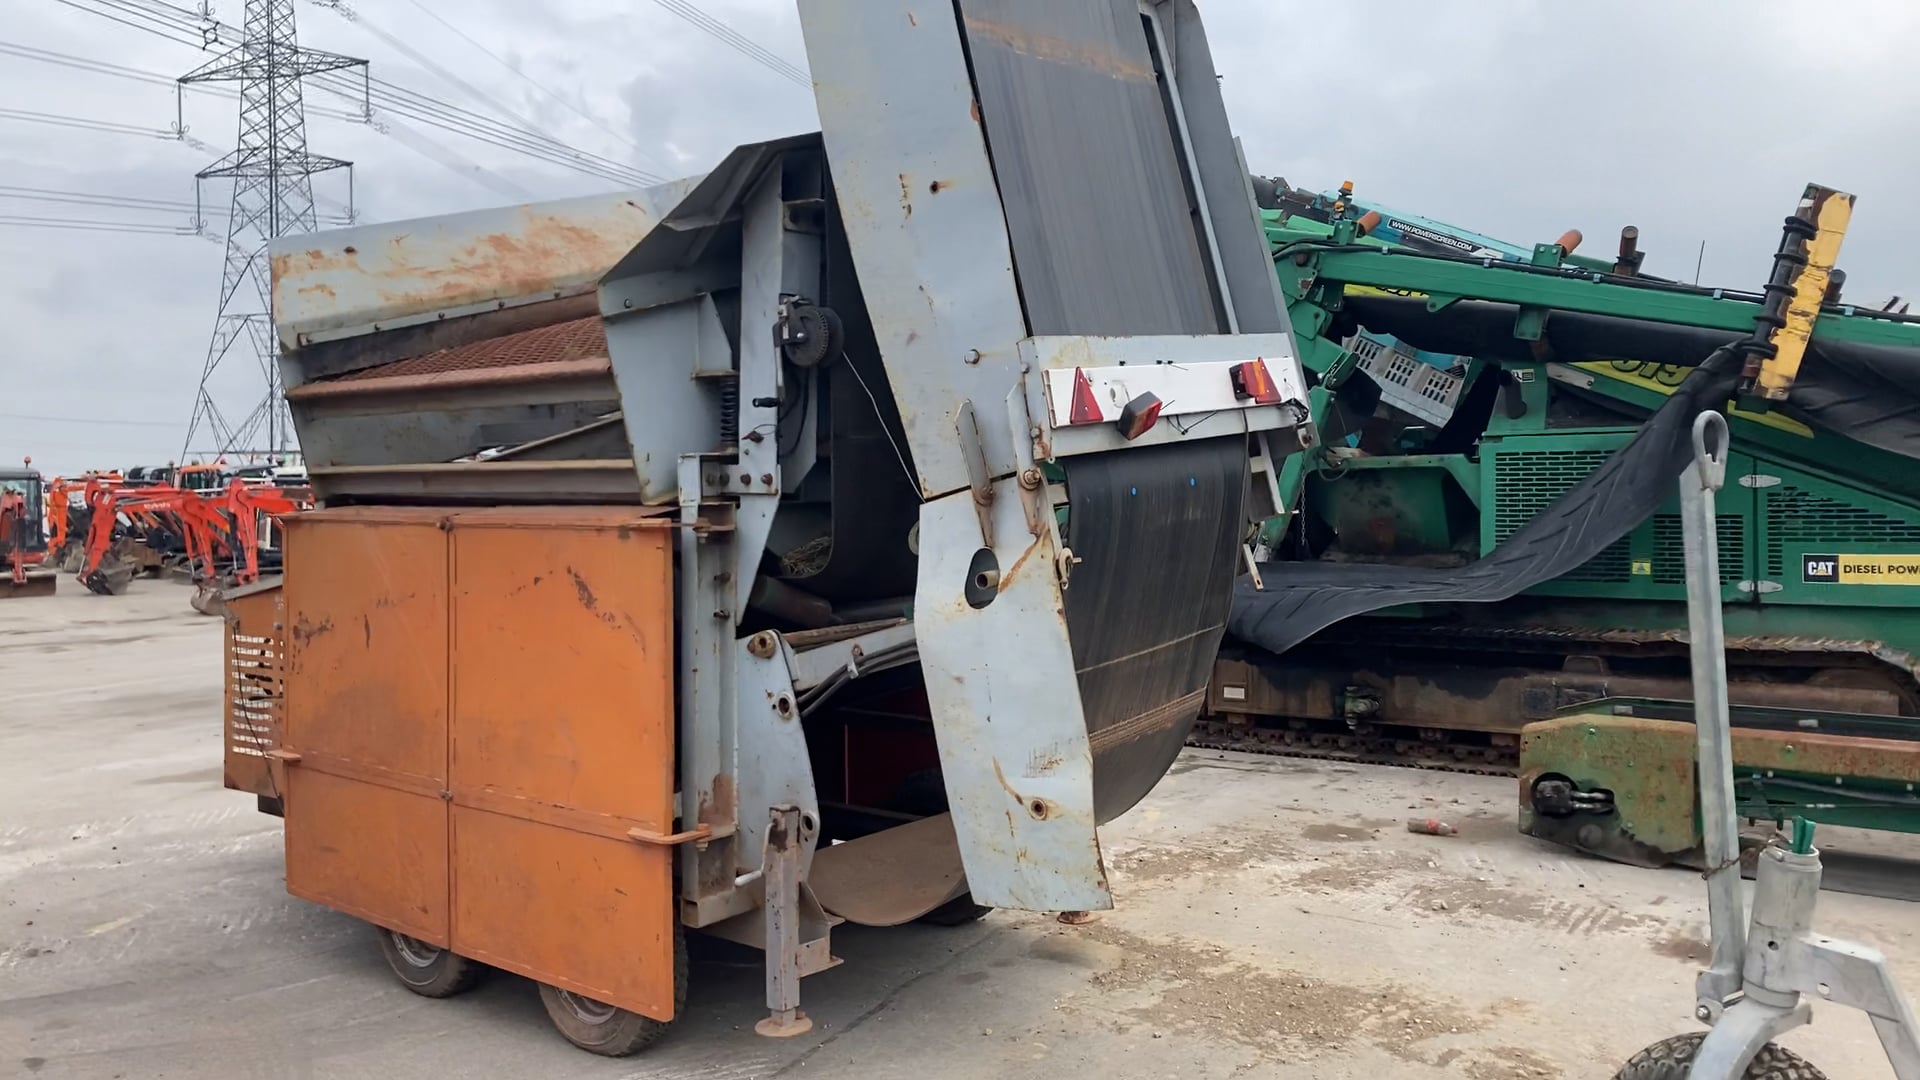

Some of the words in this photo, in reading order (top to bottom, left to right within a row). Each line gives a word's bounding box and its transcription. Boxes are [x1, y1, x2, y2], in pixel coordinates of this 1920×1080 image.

[1391, 220, 1472, 252] WWW.POWERSCREEN.COM
[1808, 561, 1835, 576] CAT
[1843, 564, 1884, 574] DIESEL
[1887, 564, 1920, 575] POW
